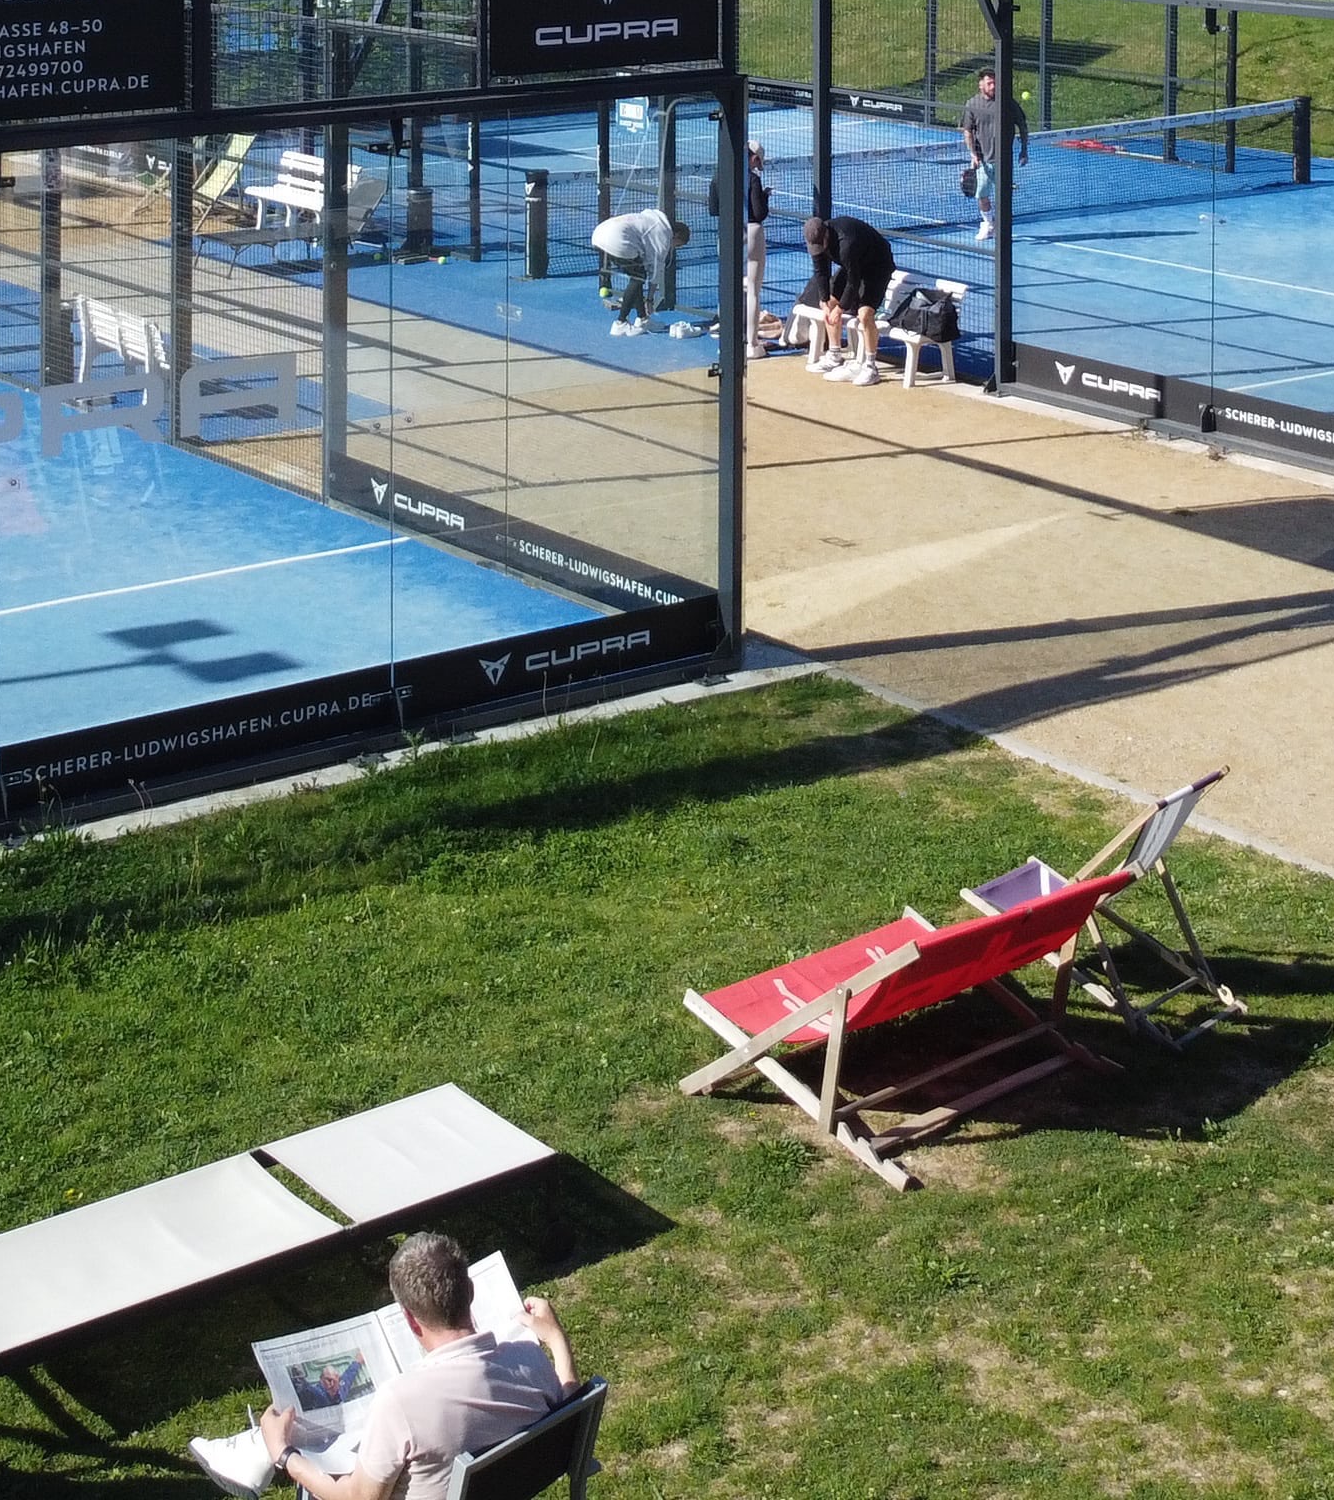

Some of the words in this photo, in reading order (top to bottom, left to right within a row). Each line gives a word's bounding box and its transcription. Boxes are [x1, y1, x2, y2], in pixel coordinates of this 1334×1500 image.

[48, 18, 103, 36] 48-50
[535, 18, 679, 47] CUPRA
[862, 99, 903, 113] CUPRA
[1081, 372, 1161, 403] CUPRA
[393, 491, 465, 531] CUPRA
[524, 629, 651, 672] CUPRA
[22, 692, 373, 785] SCHERER-LUDWIGSHAFEN.CUPRA.DE
